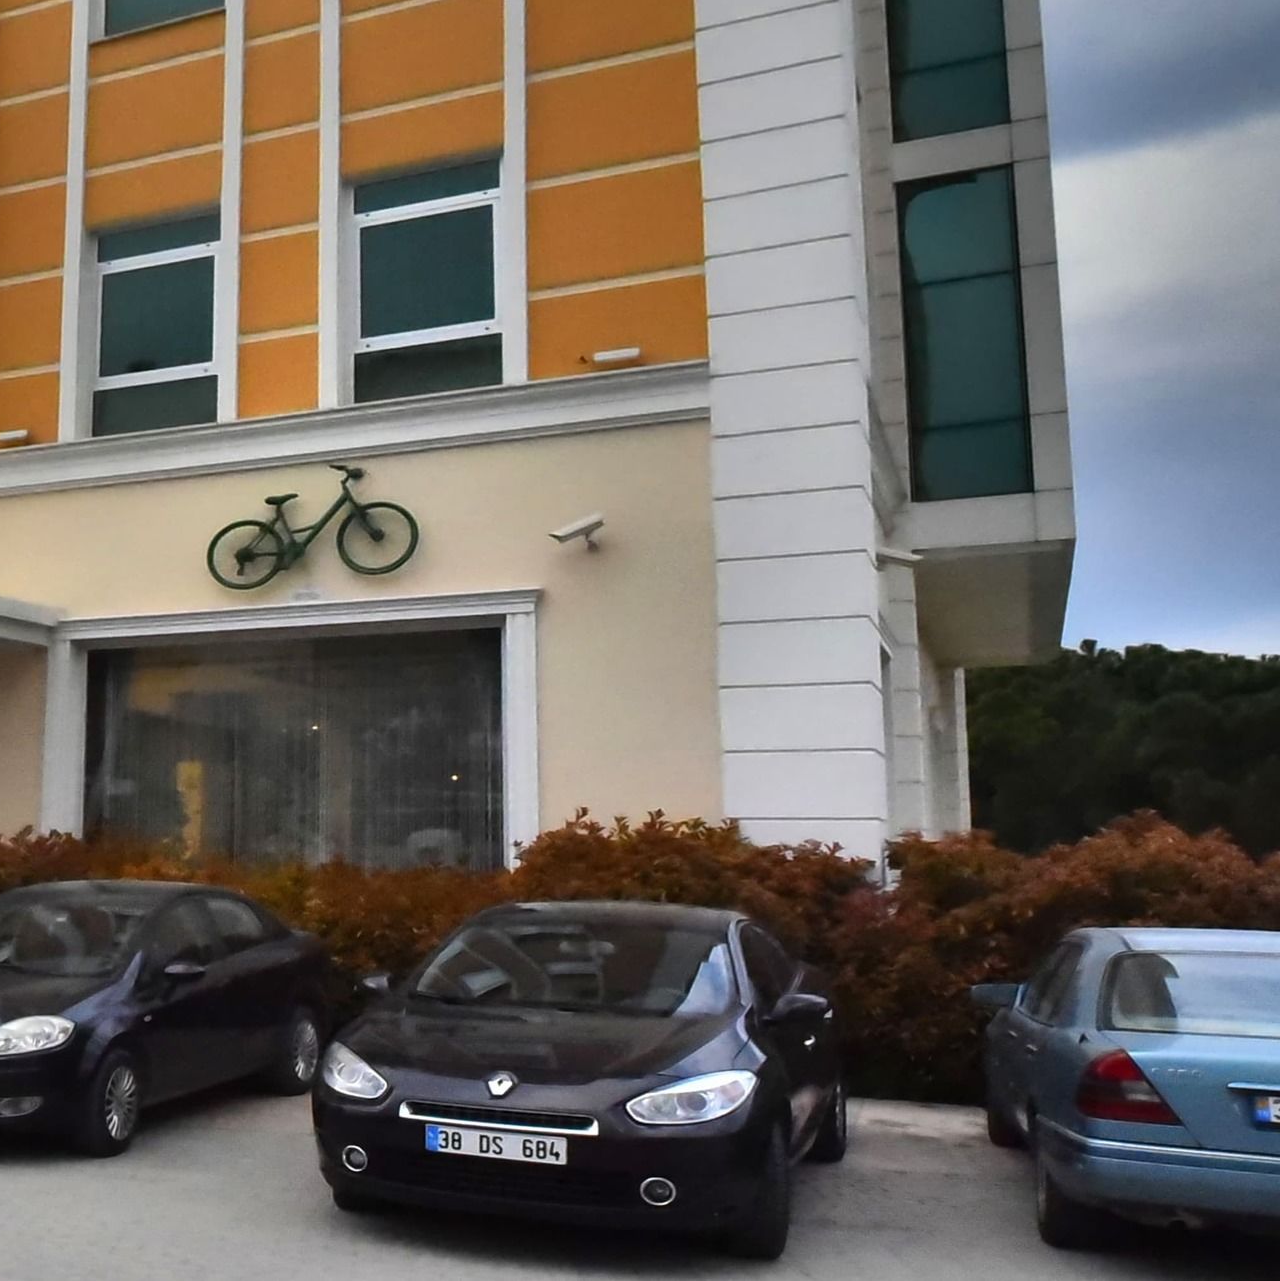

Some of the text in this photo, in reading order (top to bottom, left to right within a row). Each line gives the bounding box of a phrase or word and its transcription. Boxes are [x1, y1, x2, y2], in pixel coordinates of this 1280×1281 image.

[438, 1130, 561, 1161] 38 DS 684
